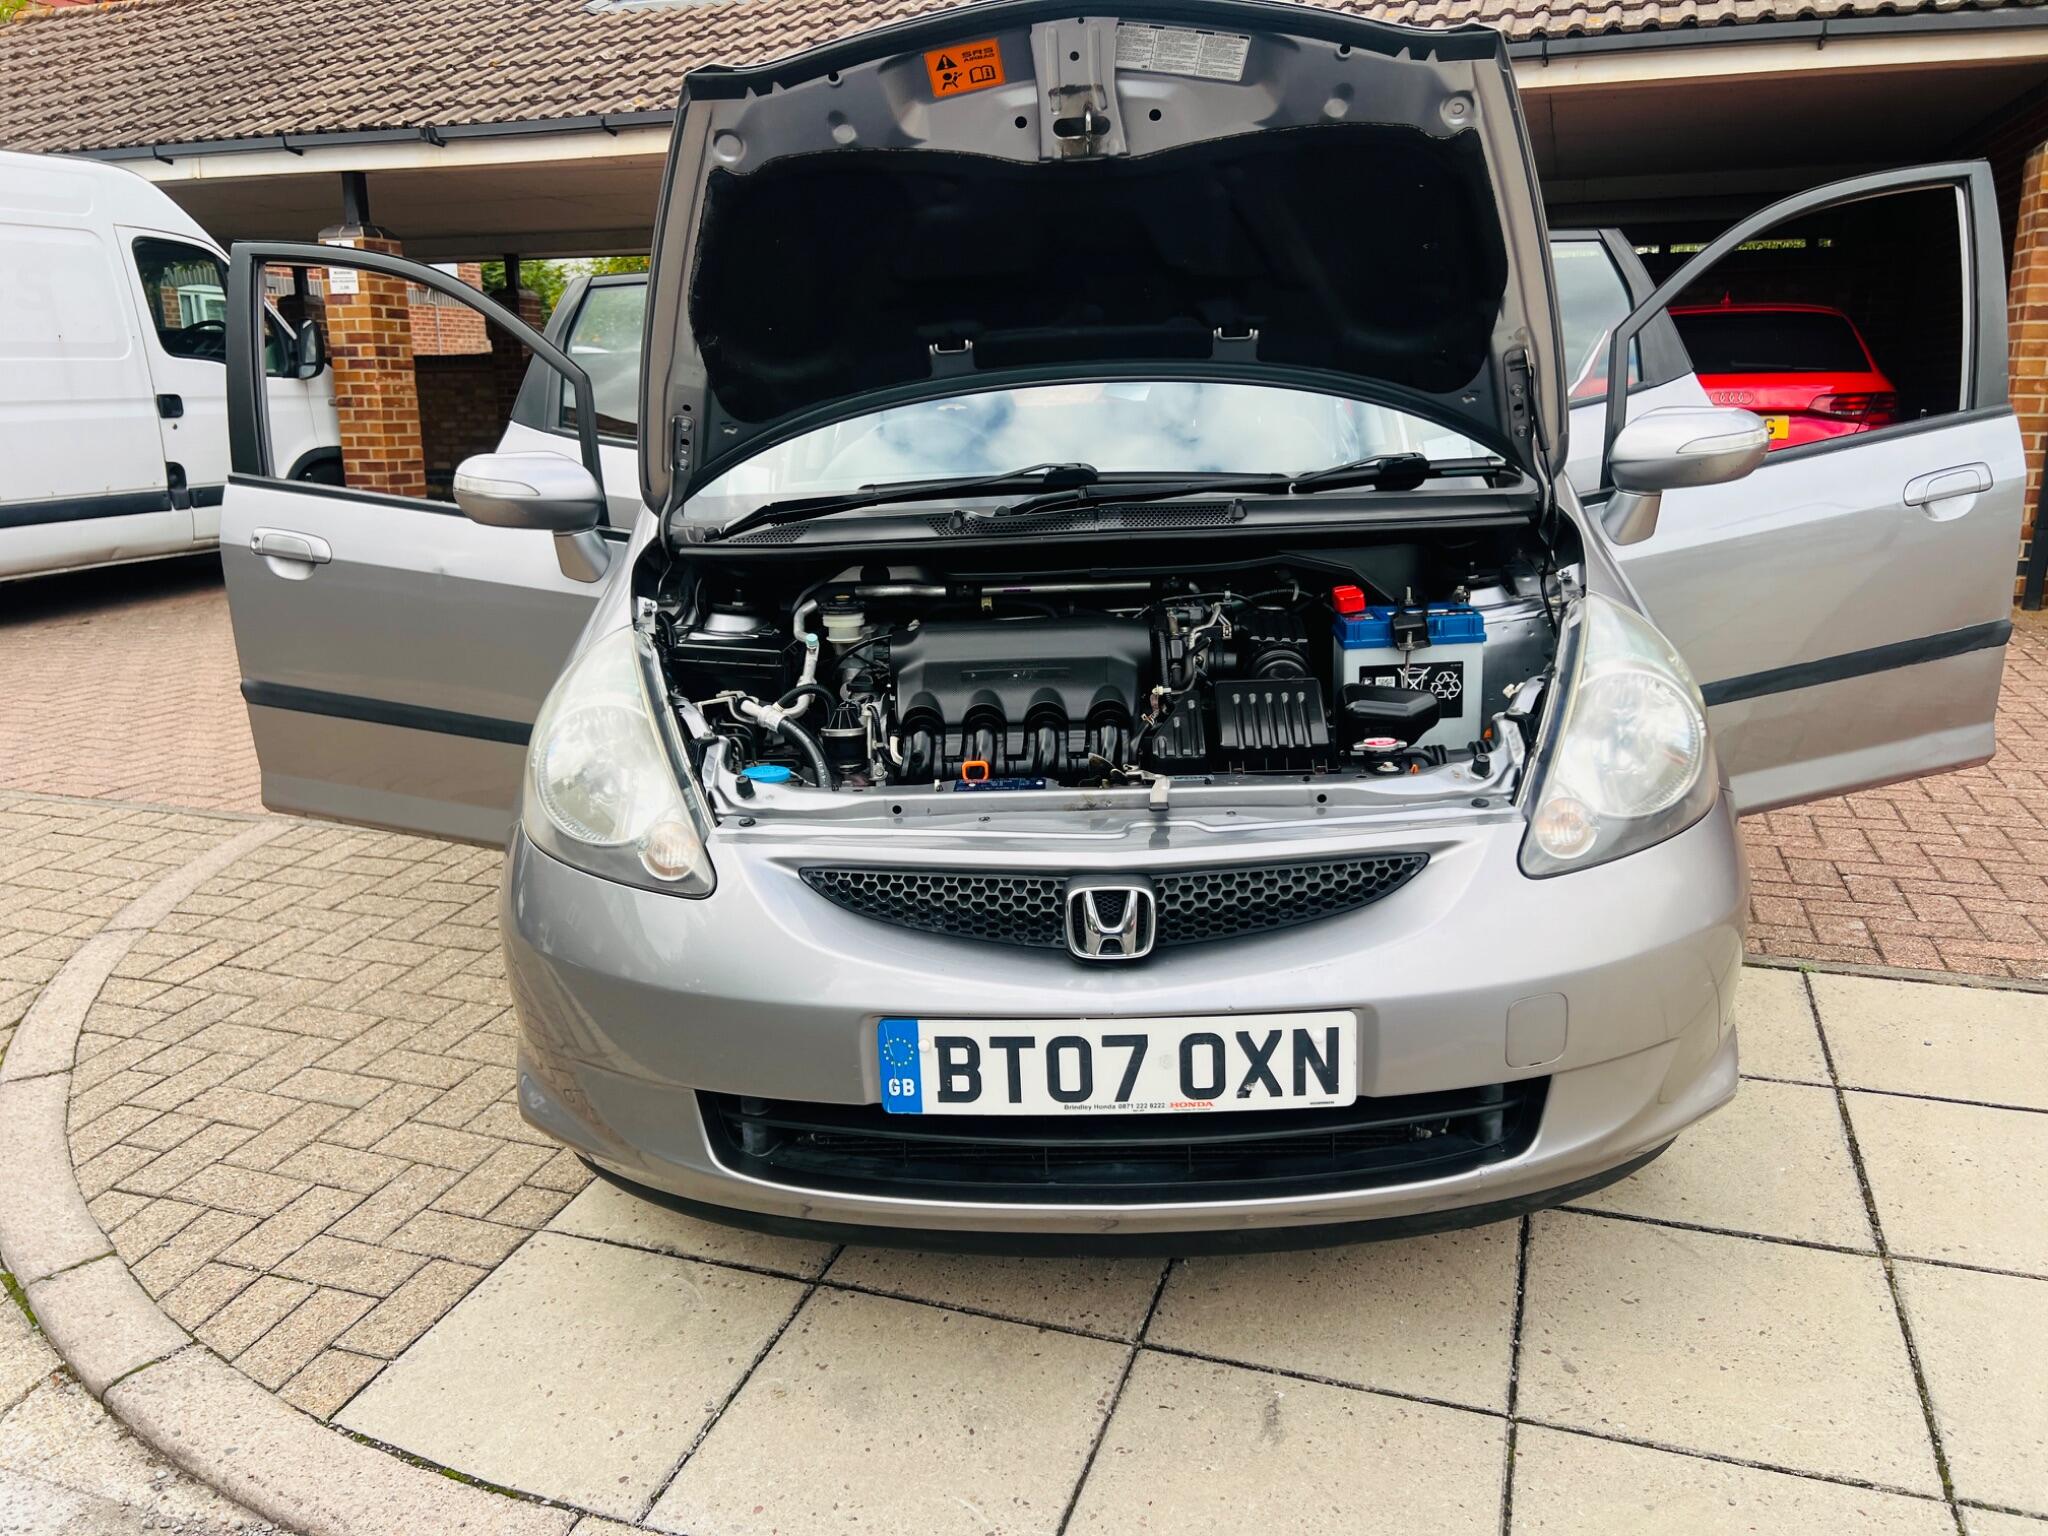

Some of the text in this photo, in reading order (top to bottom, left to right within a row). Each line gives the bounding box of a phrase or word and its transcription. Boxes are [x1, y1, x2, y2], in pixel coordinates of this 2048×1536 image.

[962, 47, 994, 59] SRS
[934, 1027, 1339, 1104] BT07 OXN
[888, 1078, 915, 1097] GB
